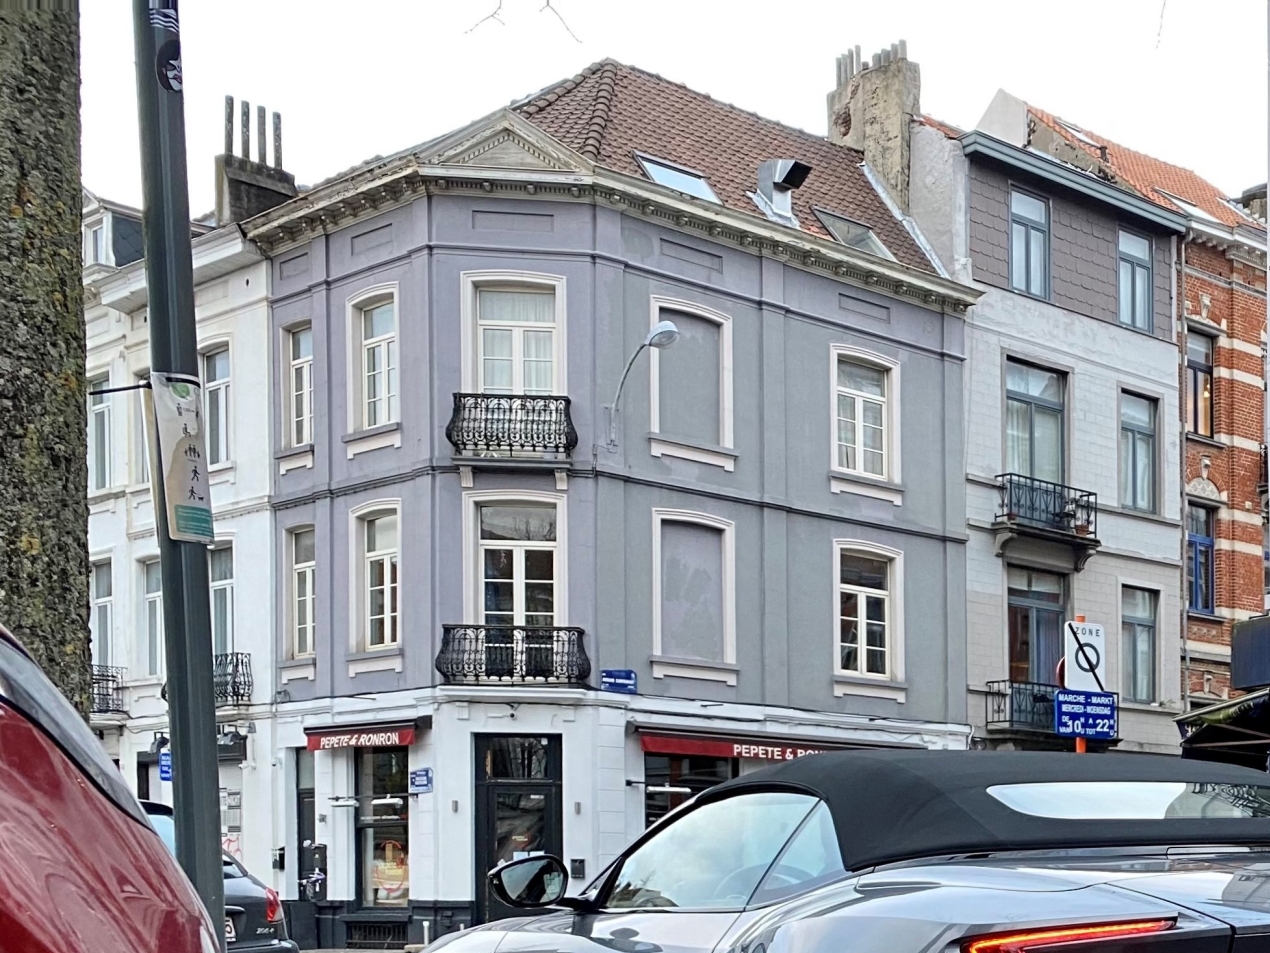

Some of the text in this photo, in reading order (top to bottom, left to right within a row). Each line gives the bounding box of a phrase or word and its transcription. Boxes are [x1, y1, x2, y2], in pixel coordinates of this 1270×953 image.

[1075, 627, 1100, 637] ZONE
[1058, 694, 1085, 703] MARCHE
[1091, 696, 1113, 705] MARKT
[1067, 719, 1081, 733] 10
[1096, 719, 1109, 732] 22
[320, 732, 399, 749] PEPETE & RONRON
[733, 744, 783, 760] PEPETE
[785, 748, 794, 760] &
